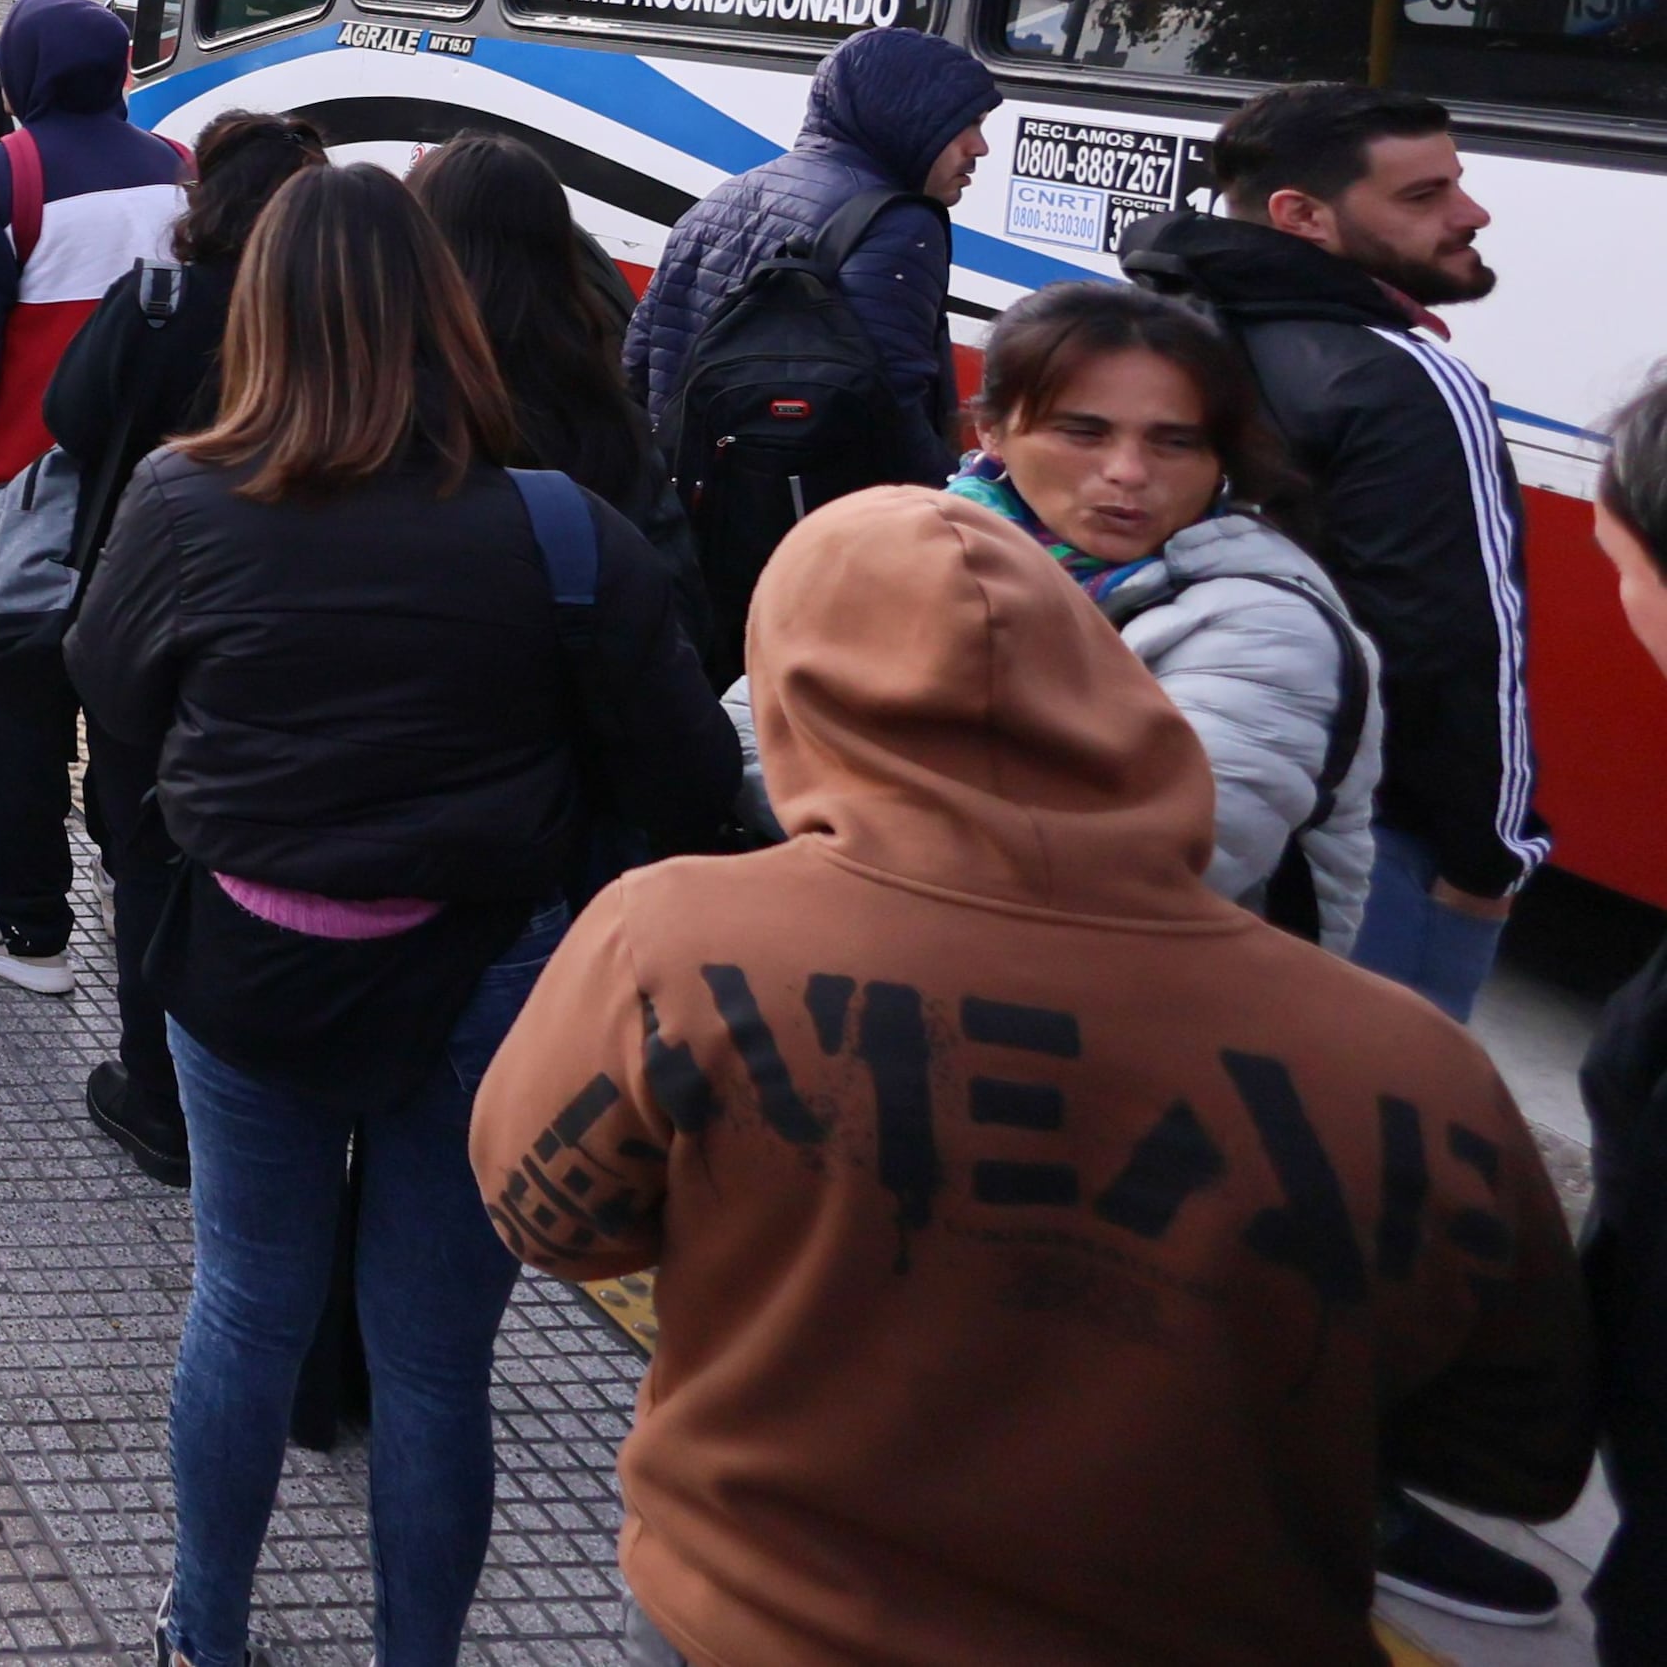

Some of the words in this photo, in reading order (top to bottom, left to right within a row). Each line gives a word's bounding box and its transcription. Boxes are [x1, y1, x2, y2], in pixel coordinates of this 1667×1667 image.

[337, 25, 421, 54] AGRALE
[429, 34, 448, 51] MT
[448, 37, 472, 54] 15.0
[1024, 120, 1135, 148] RECLAMOS
[1140, 137, 1168, 153] AL
[1017, 138, 1172, 195] 0800-8887267
[1017, 186, 1095, 212] CNRT
[1110, 196, 1166, 213] COCHE
[1012, 206, 1095, 239] 0800-3330300
